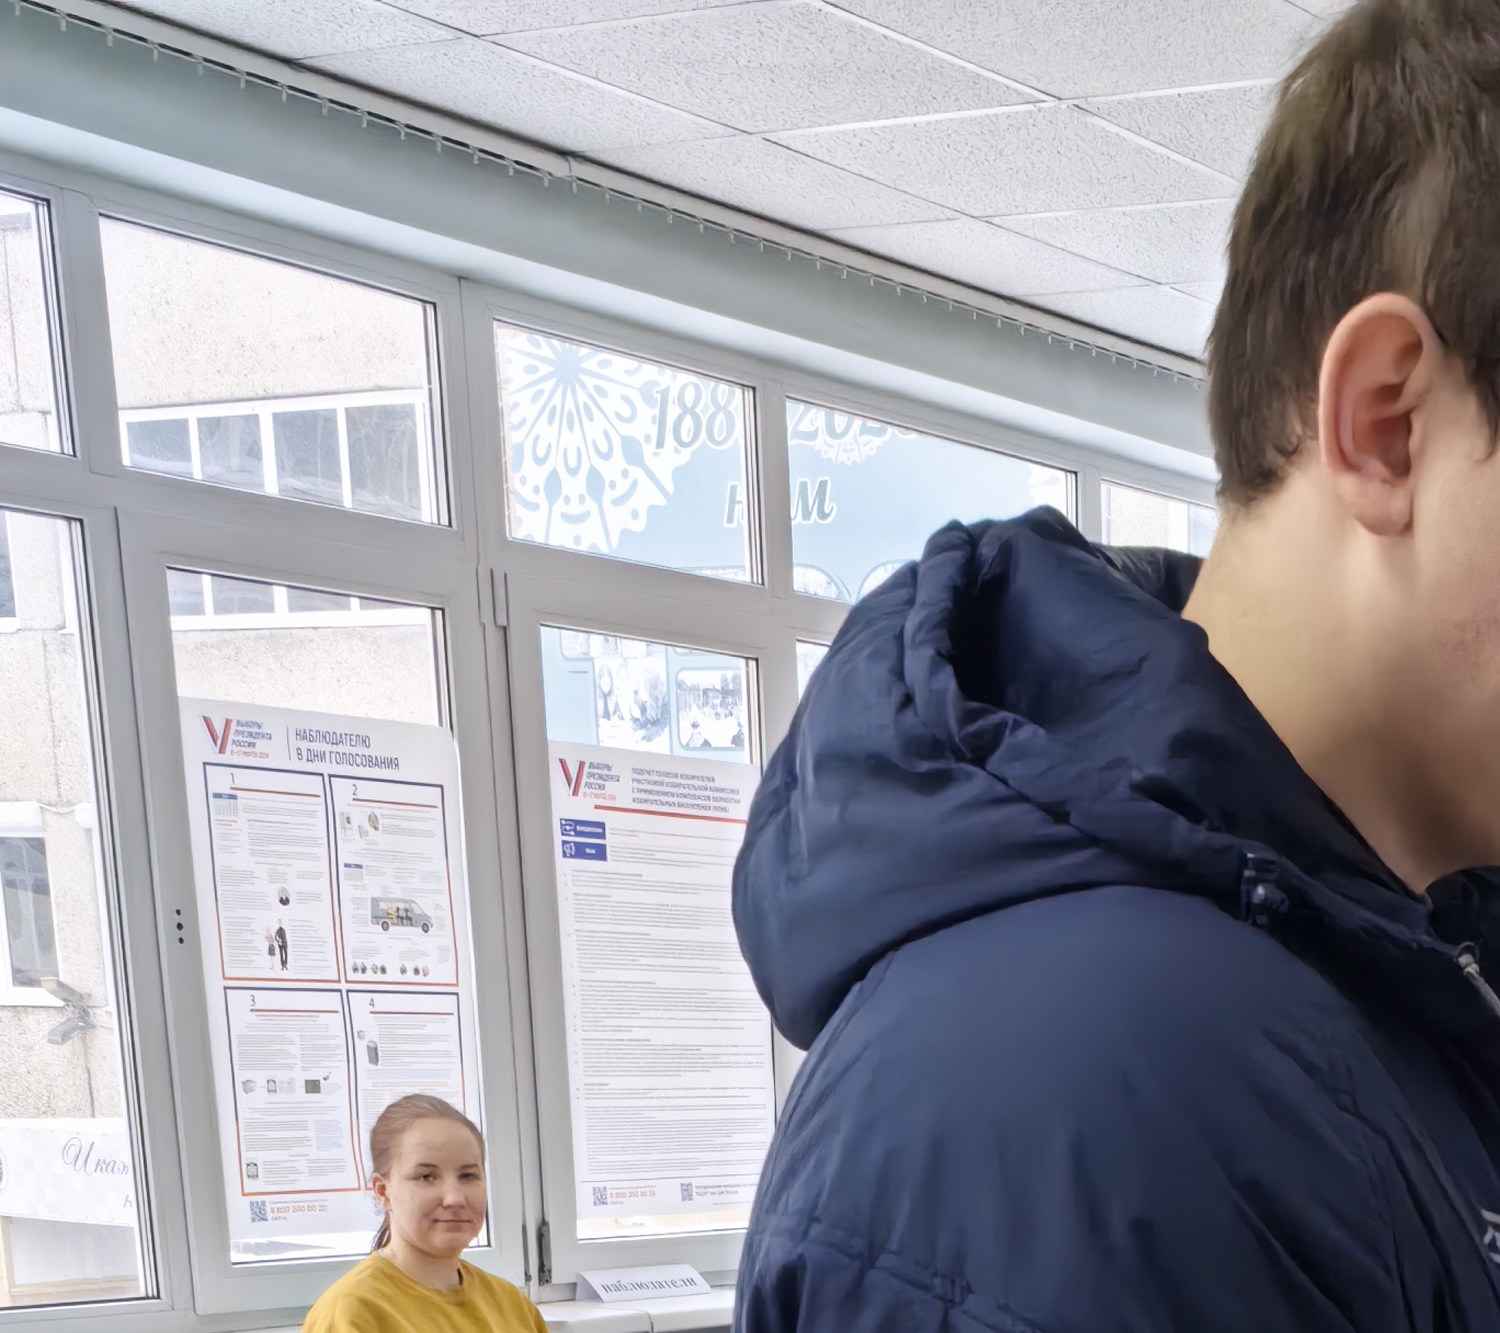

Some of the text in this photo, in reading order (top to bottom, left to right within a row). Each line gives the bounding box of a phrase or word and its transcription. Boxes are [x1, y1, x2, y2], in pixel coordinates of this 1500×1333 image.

[655, 375, 745, 450] 188
[295, 728, 371, 749] НАБЛЮДАТЕЛЮ
[296, 748, 400, 771] В ДНИ ГОЛОСОВАНИЯ
[229, 772, 236, 785] 1
[352, 784, 359, 796] 2
[250, 994, 257, 1007] 3
[368, 997, 376, 1009] 4
[600, 1276, 698, 1294] наблюдатели
